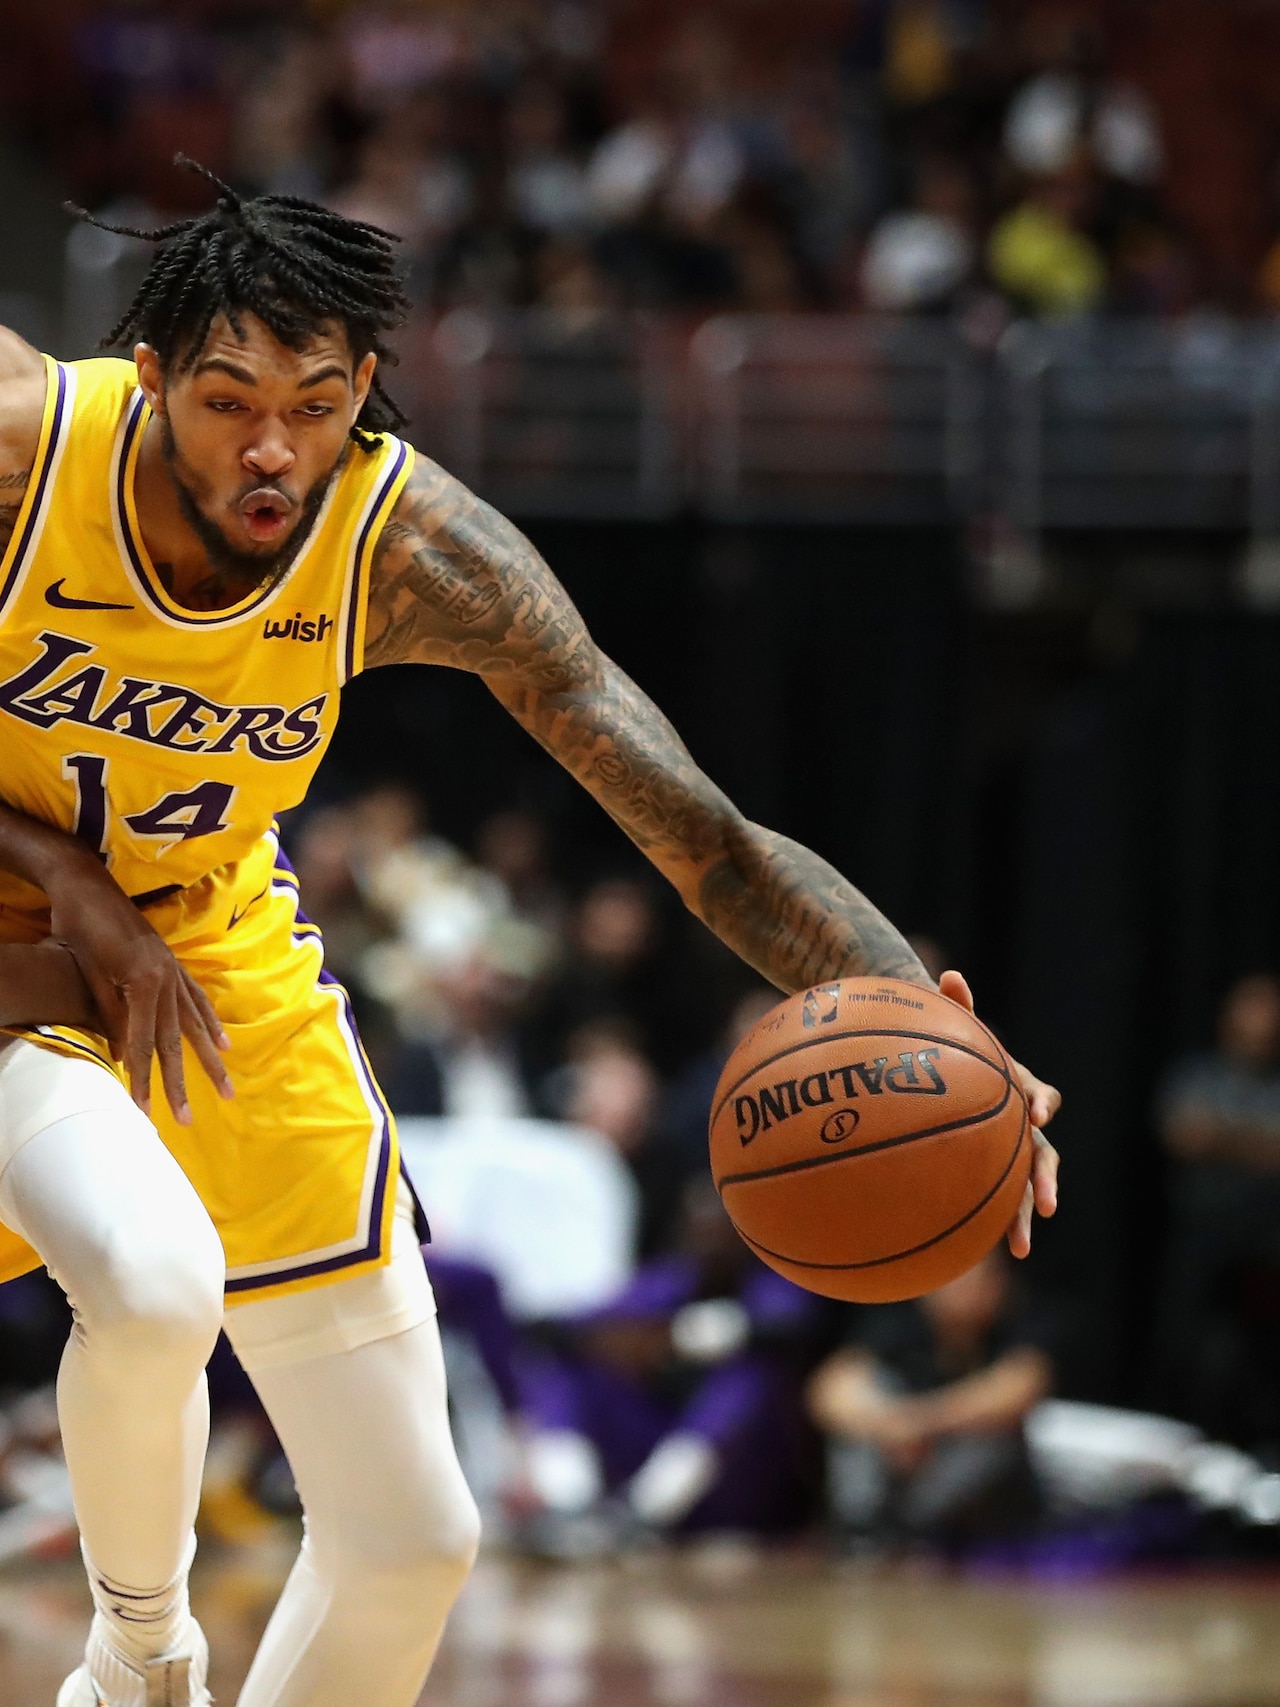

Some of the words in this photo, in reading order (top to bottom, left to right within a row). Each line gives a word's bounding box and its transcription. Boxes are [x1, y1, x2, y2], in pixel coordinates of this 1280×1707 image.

[263, 612, 334, 642] wish
[61, 751, 240, 869] 14
[734, 1047, 947, 1147] SPALDING
